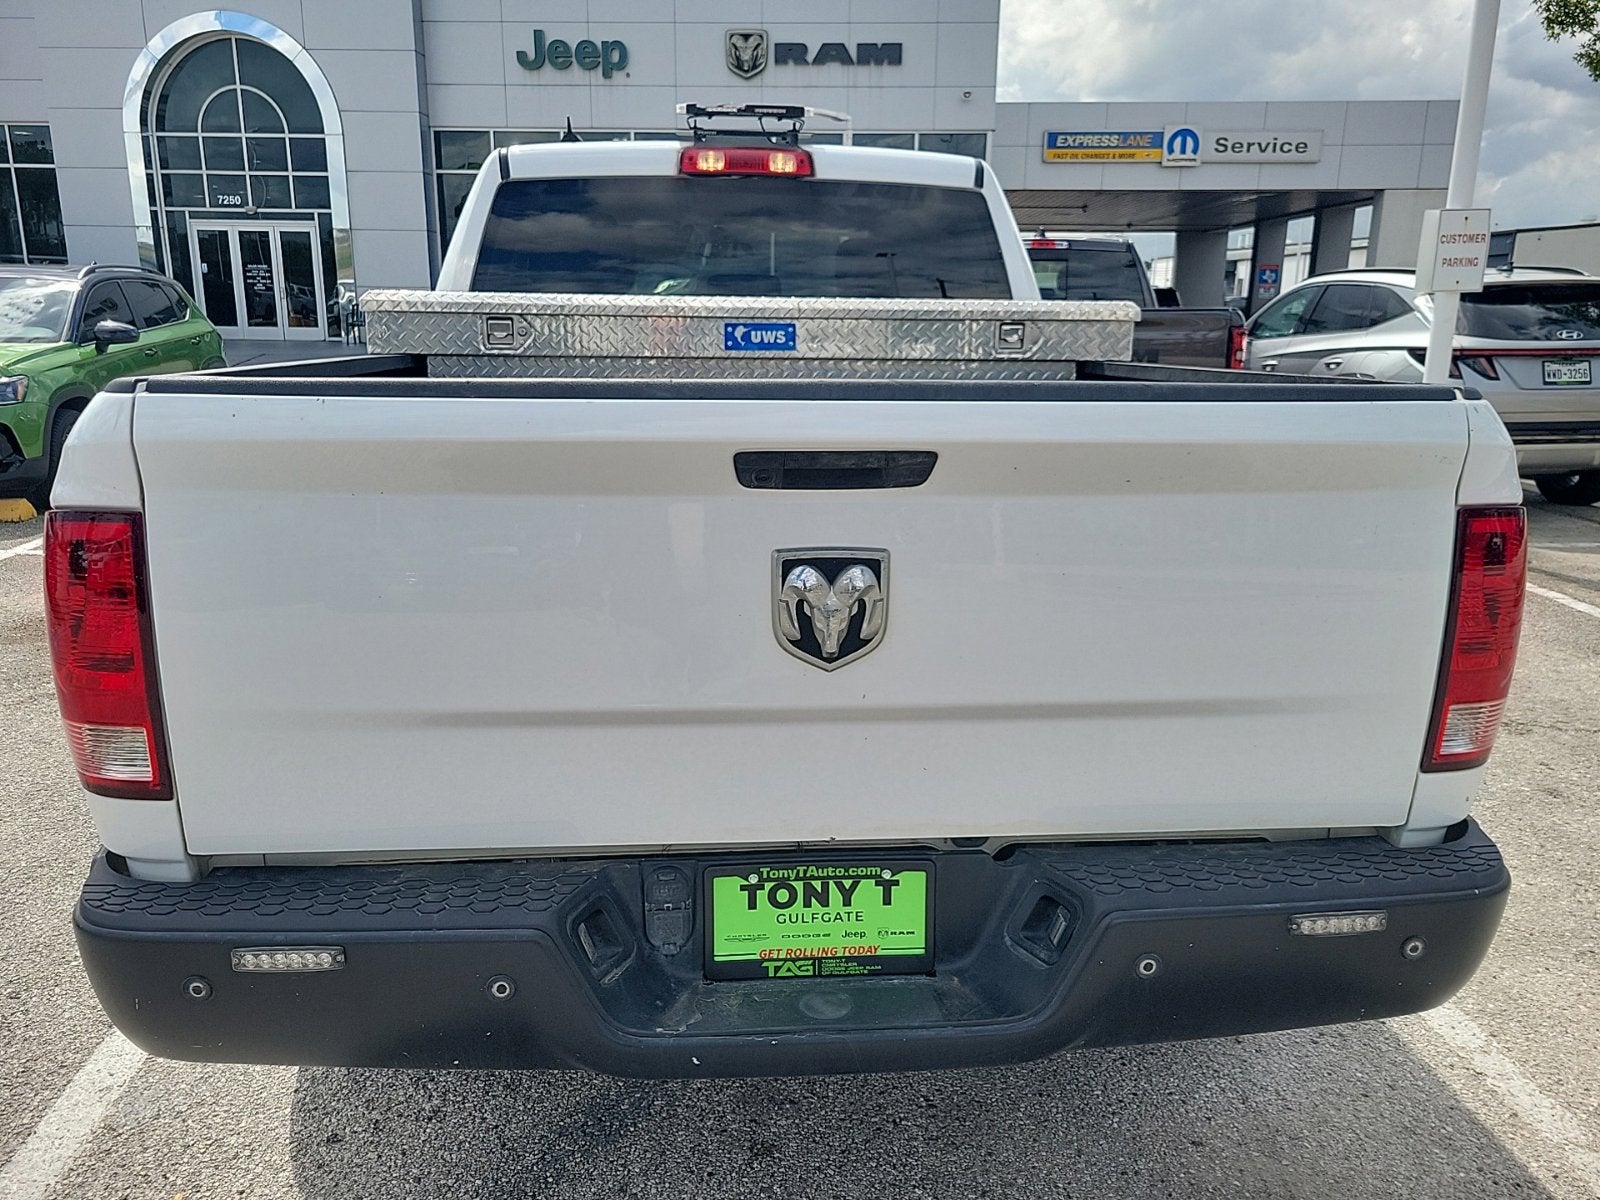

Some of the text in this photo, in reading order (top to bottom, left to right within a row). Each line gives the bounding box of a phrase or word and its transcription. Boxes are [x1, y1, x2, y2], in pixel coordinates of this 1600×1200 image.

[516, 29, 628, 79] Jeep
[774, 42, 903, 66] RAM
[1214, 136, 1309, 155] Service
[217, 194, 242, 206] 7250
[1440, 233, 1487, 245] CUSTOMER
[1442, 257, 1479, 268] PARKING
[750, 330, 786, 344] UWS
[760, 865, 881, 880] TonyTAuto.com
[740, 879, 900, 911] TONY T
[776, 911, 864, 925] GULFGATE
[841, 929, 867, 940] Jeep
[759, 945, 881, 959] GET ROLLING TODAY
[761, 960, 814, 977] TAG
